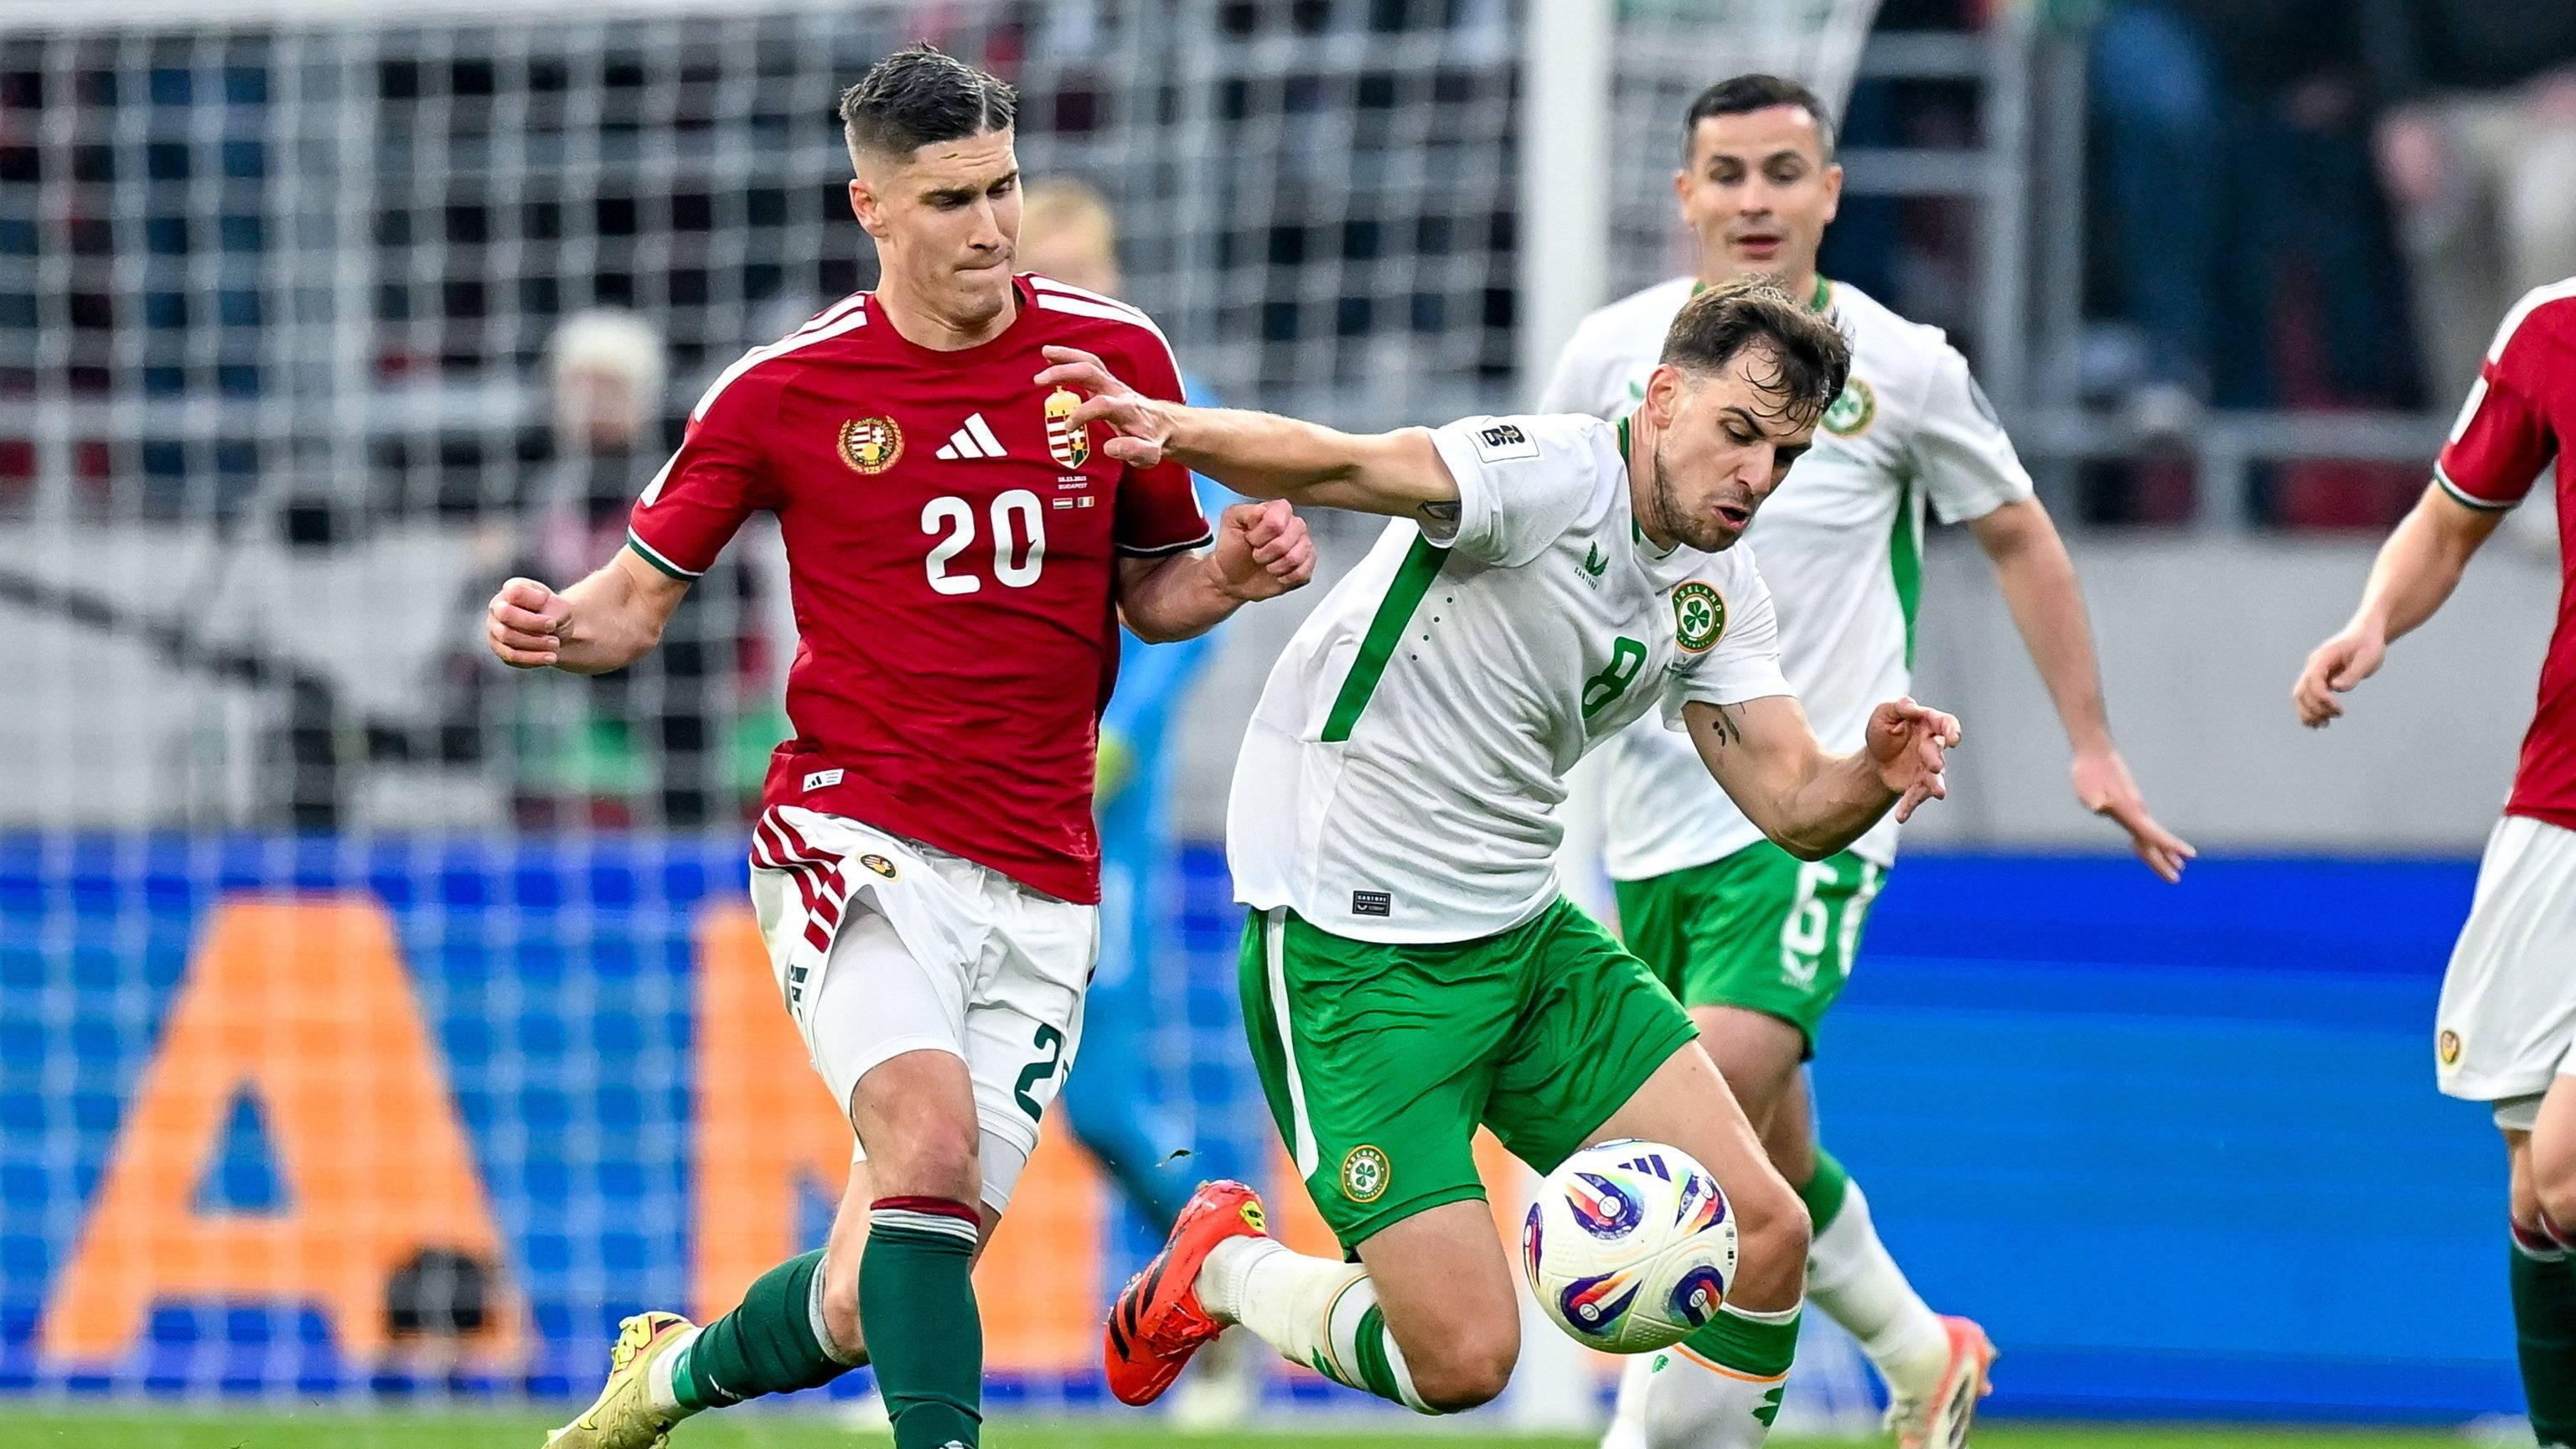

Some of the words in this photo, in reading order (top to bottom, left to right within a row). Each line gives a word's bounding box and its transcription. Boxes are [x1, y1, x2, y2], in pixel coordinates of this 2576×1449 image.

[921, 489, 1046, 595] 20
[1675, 585, 1722, 612] IRELAND
[1581, 635, 1648, 719] 8
[1780, 861, 1839, 955] 6
[1014, 1022, 1070, 1124] 2
[1344, 1149, 1381, 1174] IRELAND
